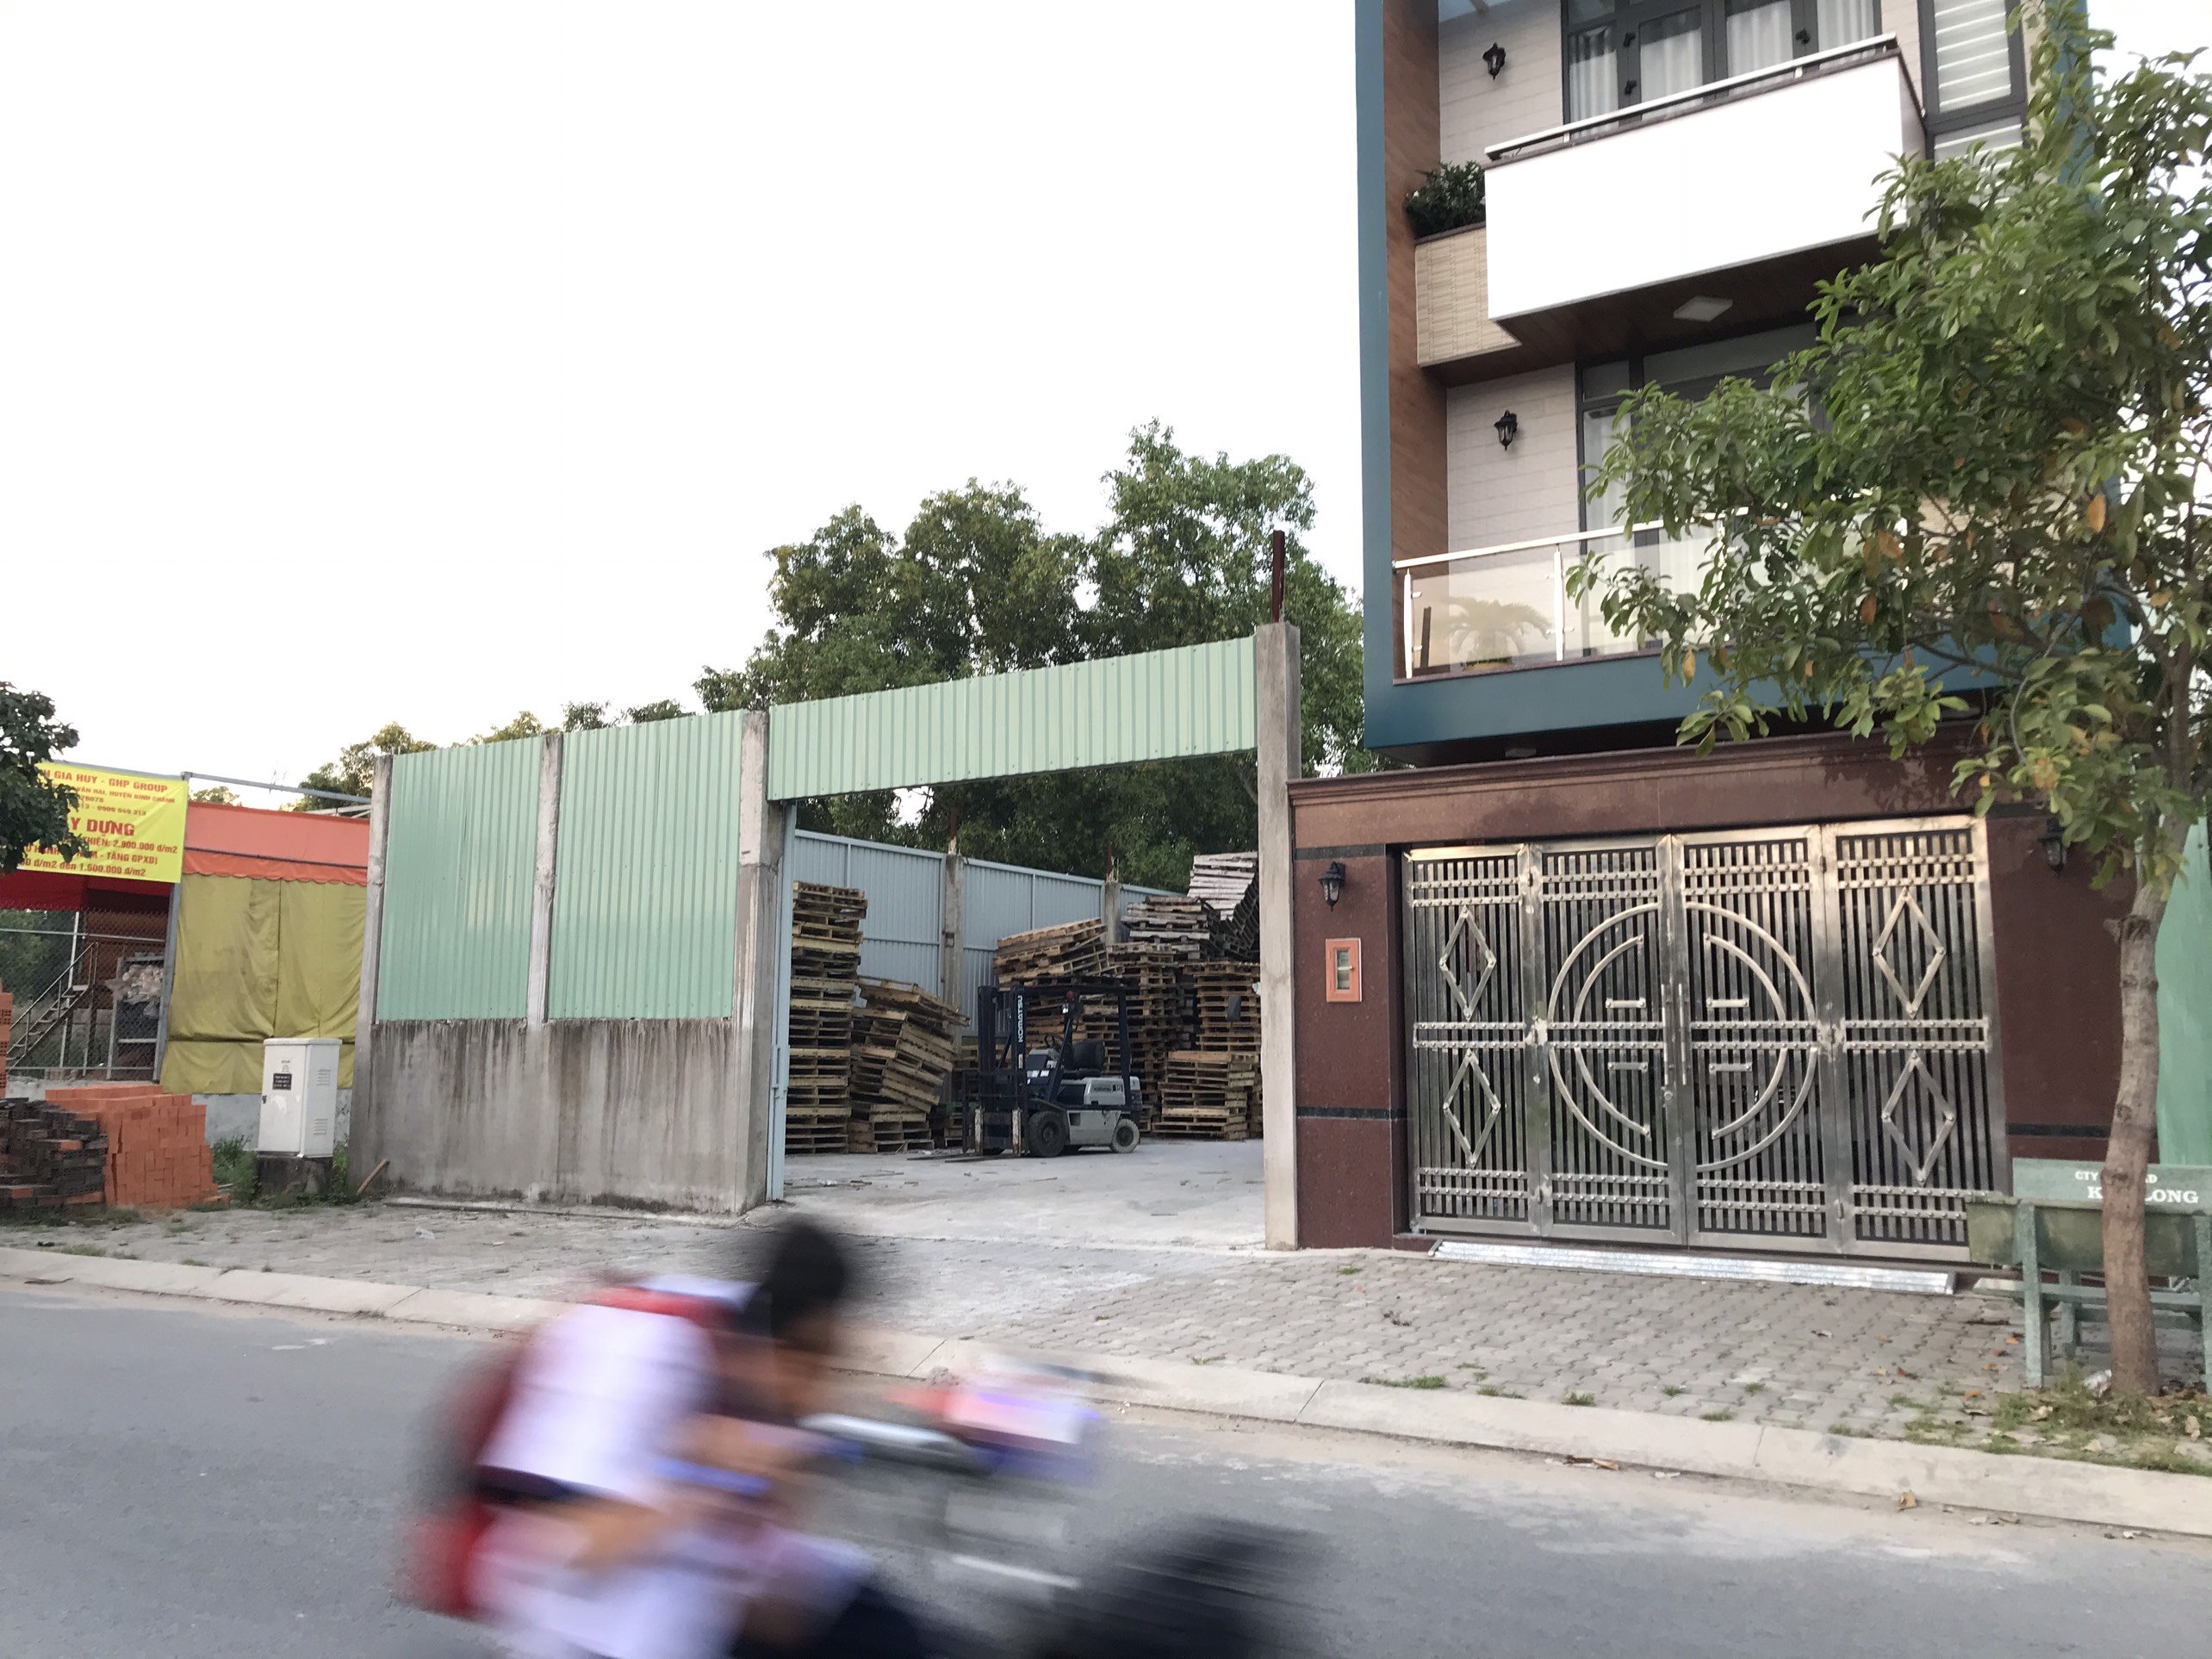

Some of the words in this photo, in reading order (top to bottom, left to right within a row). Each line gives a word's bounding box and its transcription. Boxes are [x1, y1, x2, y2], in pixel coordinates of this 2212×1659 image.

[54, 771, 72, 780] GIA
[77, 774, 97, 784] HUY
[134, 781, 168, 792] GROUP
[87, 818, 135, 836] DỰNG
[2074, 1170, 2099, 1181] CTY
